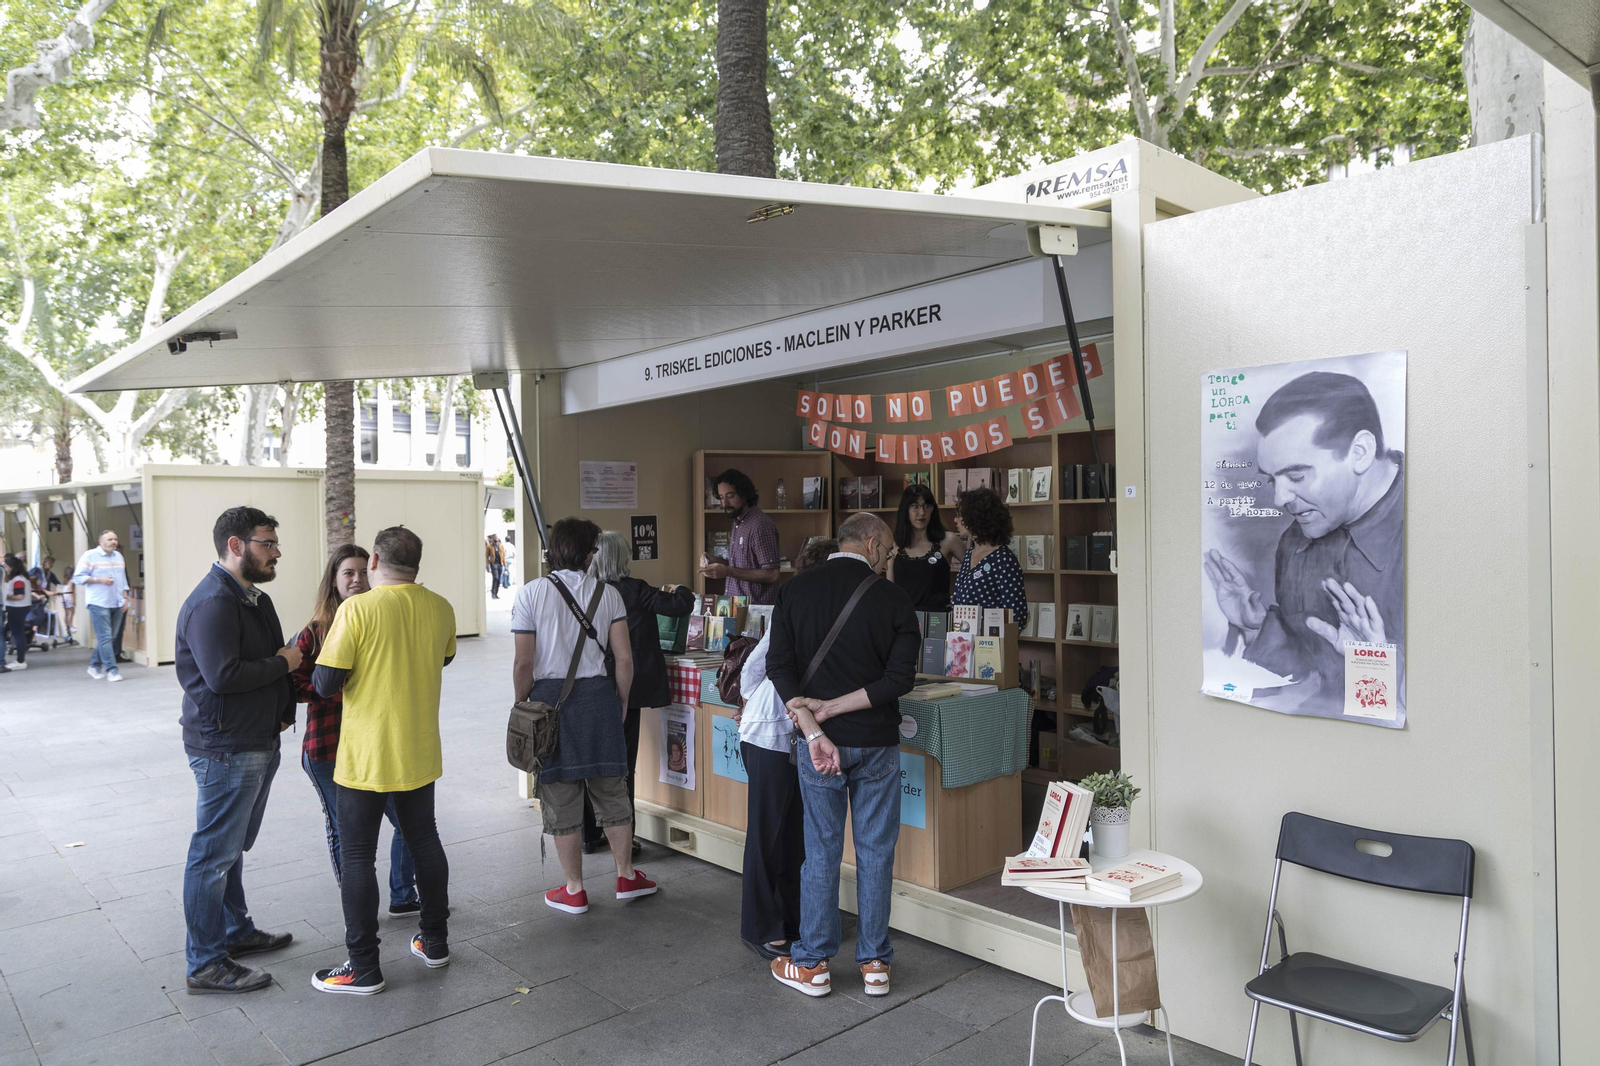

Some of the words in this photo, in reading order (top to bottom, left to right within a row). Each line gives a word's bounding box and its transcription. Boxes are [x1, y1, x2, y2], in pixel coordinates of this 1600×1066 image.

[1036, 158, 1128, 198] REMSA
[1057, 175, 1128, 200] www.remsa.net
[1090, 191, 1101, 199] 954
[1102, 188, 1111, 197] 40
[1111, 185, 1120, 194] 50
[1121, 183, 1129, 191] 21
[644, 367, 653, 381] 9.
[656, 356, 702, 379] TRISKEL
[704, 340, 772, 369] EDICIONES
[784, 323, 850, 353] MACLEIN
[854, 320, 866, 338] Y
[869, 303, 943, 335] PARKER
[1208, 373, 1245, 385] Tengo
[1212, 387, 1226, 396] un
[800, 395, 866, 419] SOLO
[889, 396, 925, 418] NO
[1211, 395, 1250, 408] LORCA
[1209, 411, 1237, 423] para
[1226, 420, 1237, 430] ti
[810, 423, 861, 453] CON
[879, 423, 1003, 460] LIBROS
[1216, 460, 1252, 469] Sábado
[1204, 480, 1216, 489] 12
[1220, 480, 1233, 489] de
[1237, 481, 1262, 490] mayo
[1127, 487, 1133, 496] 9
[1207, 497, 1214, 505] A
[1219, 497, 1256, 507] partir
[1230, 507, 1241, 516] 12
[1246, 507, 1282, 516] horas.
[633, 524, 655, 538] 10%
[571, 602, 584, 620] DIGITAL
[581, 619, 591, 630] EOS
[1354, 649, 1387, 658] LORCA
[1050, 790, 1062, 803] LORCA
[1136, 862, 1166, 872] LORCA
